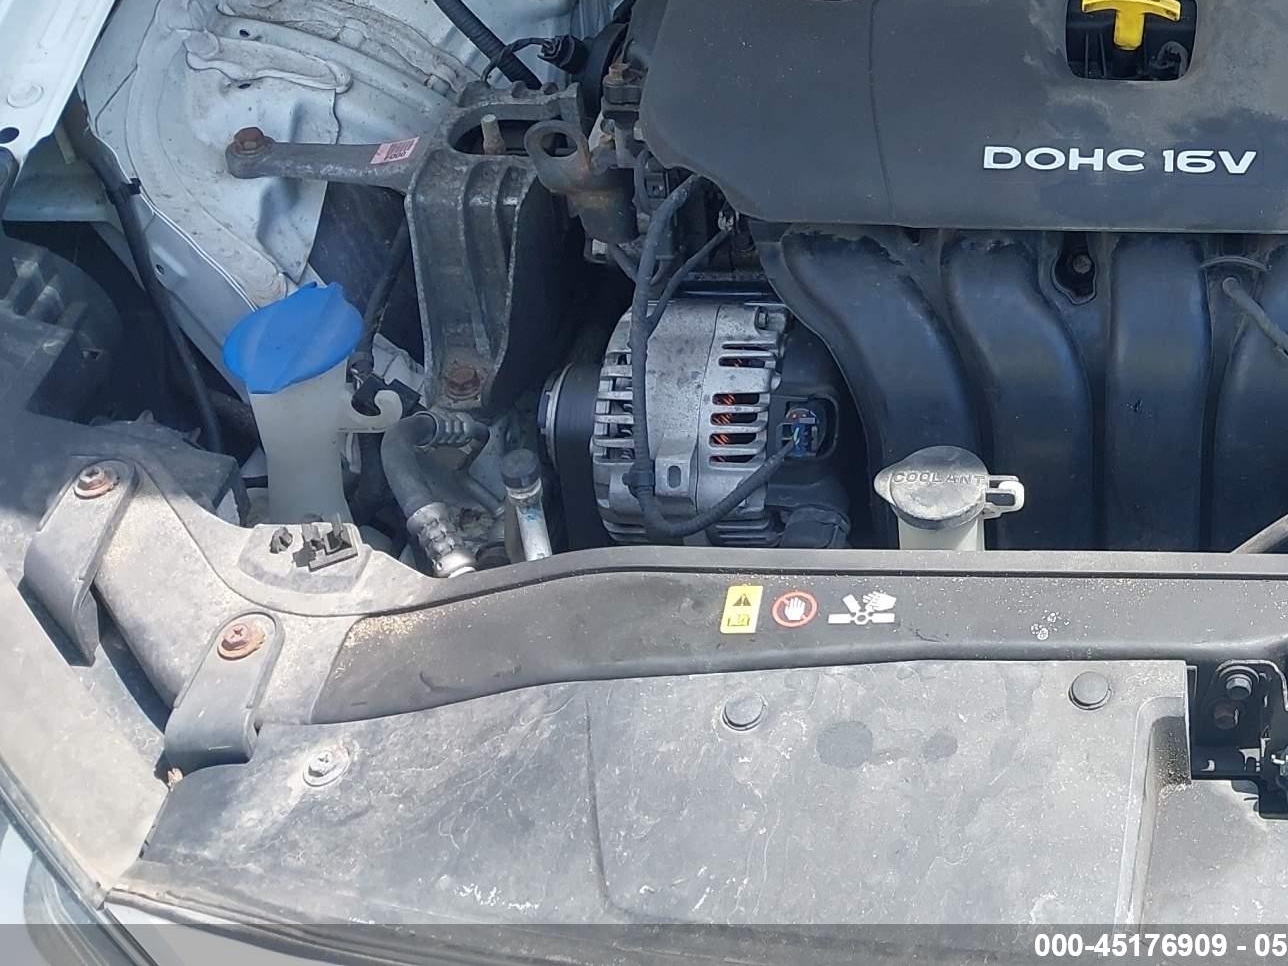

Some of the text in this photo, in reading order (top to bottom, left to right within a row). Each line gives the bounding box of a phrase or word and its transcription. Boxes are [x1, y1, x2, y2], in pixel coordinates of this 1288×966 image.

[983, 146, 1257, 174] DOHC 16V
[893, 472, 985, 484] COOLANT
